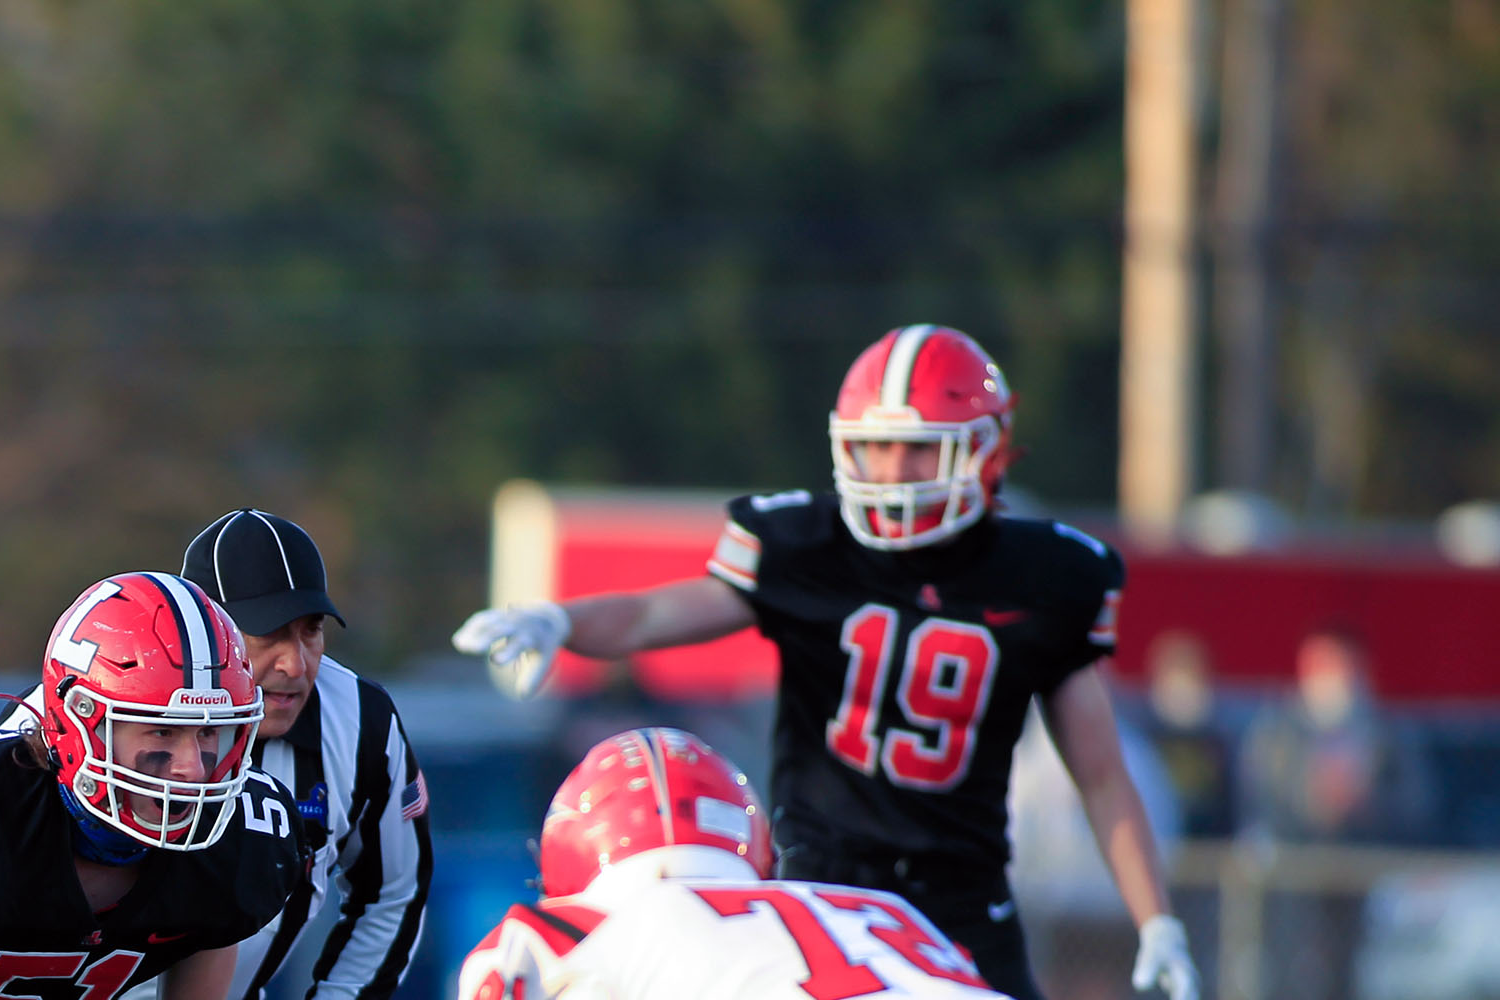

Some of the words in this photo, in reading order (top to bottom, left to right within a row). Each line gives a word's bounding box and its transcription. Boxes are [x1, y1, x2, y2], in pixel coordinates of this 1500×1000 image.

[50, 580, 123, 675] L
[180, 693, 227, 705] Riddell
[826, 603, 1001, 793] 19
